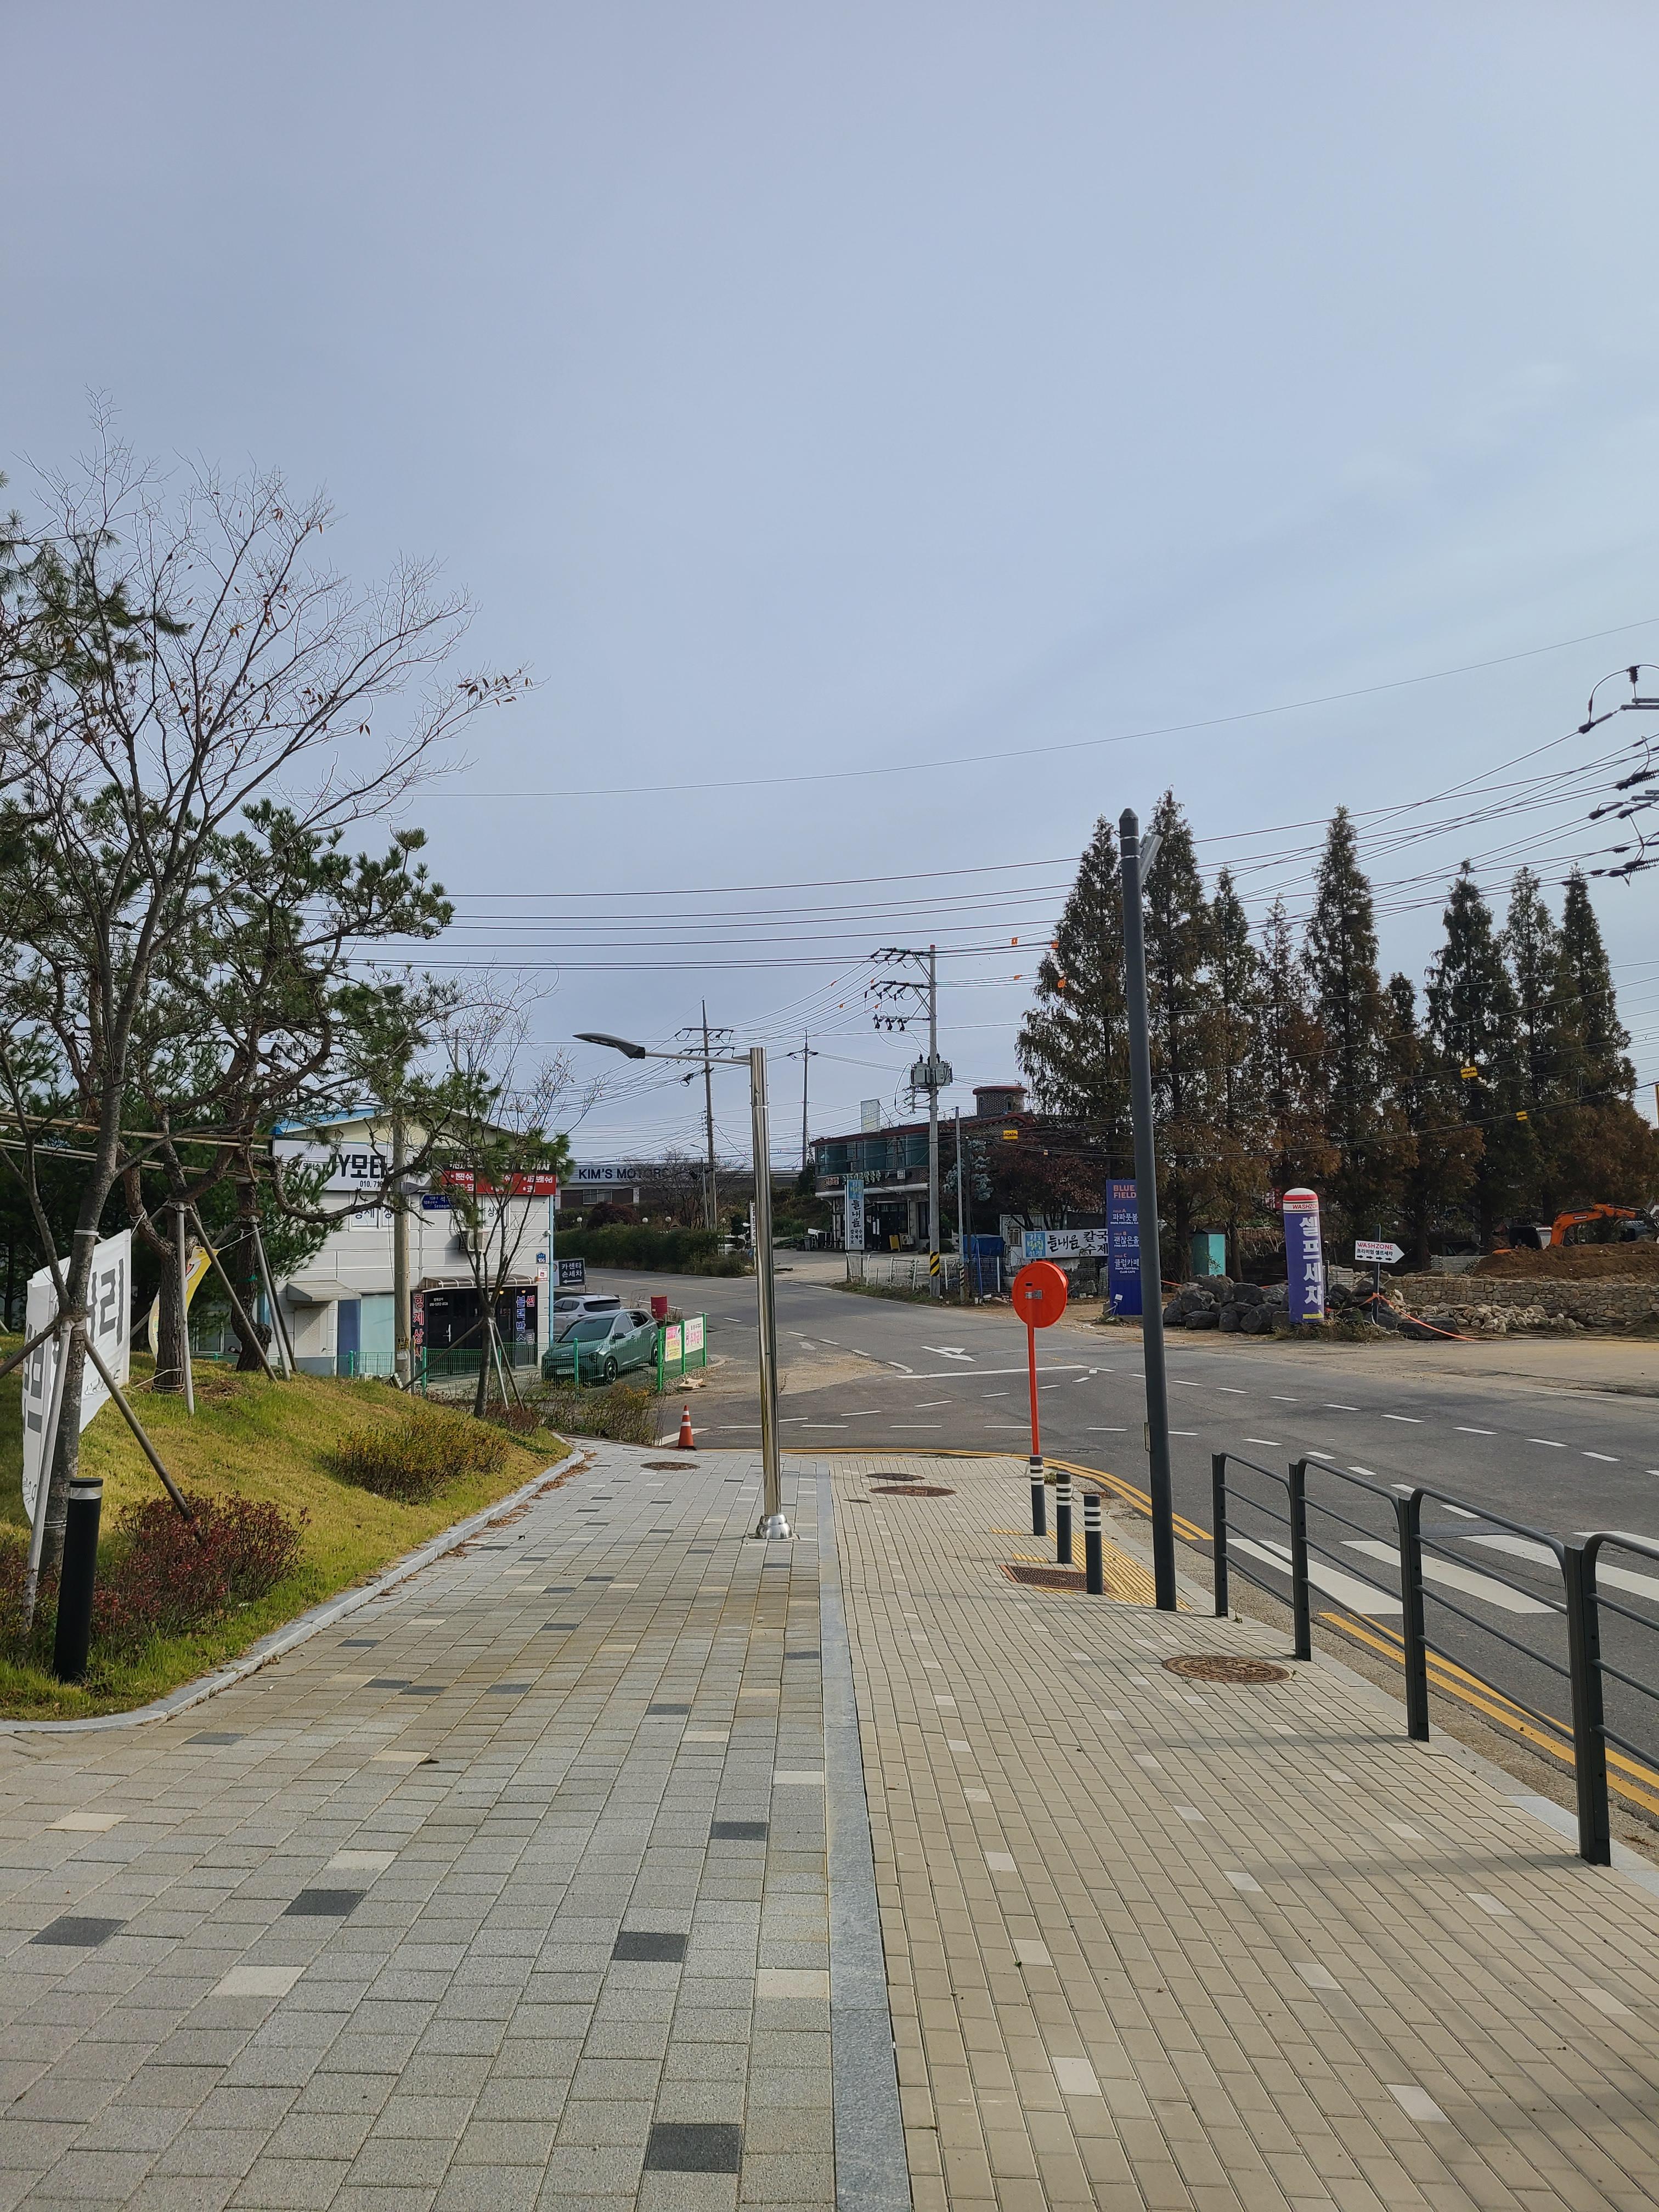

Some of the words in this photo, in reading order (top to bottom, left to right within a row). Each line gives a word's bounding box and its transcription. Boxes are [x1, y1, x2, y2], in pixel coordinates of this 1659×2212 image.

[579, 1169, 613, 1179] KIM'S
[851, 1200, 861, 1228] 들내음
[1113, 1213, 1138, 1221] 파파풋볼
[1047, 1235, 1080, 1252] 들내음
[1357, 1242, 1393, 1250] WASHZONE
[1114, 1259, 1139, 1267] 클럽카페
[1299, 1216, 1322, 1305] 셀프세차
[561, 1262, 582, 1270] 카센타
[561, 1269, 583, 1278] 손세차
[516, 1295, 526, 1346] 블랙박스
